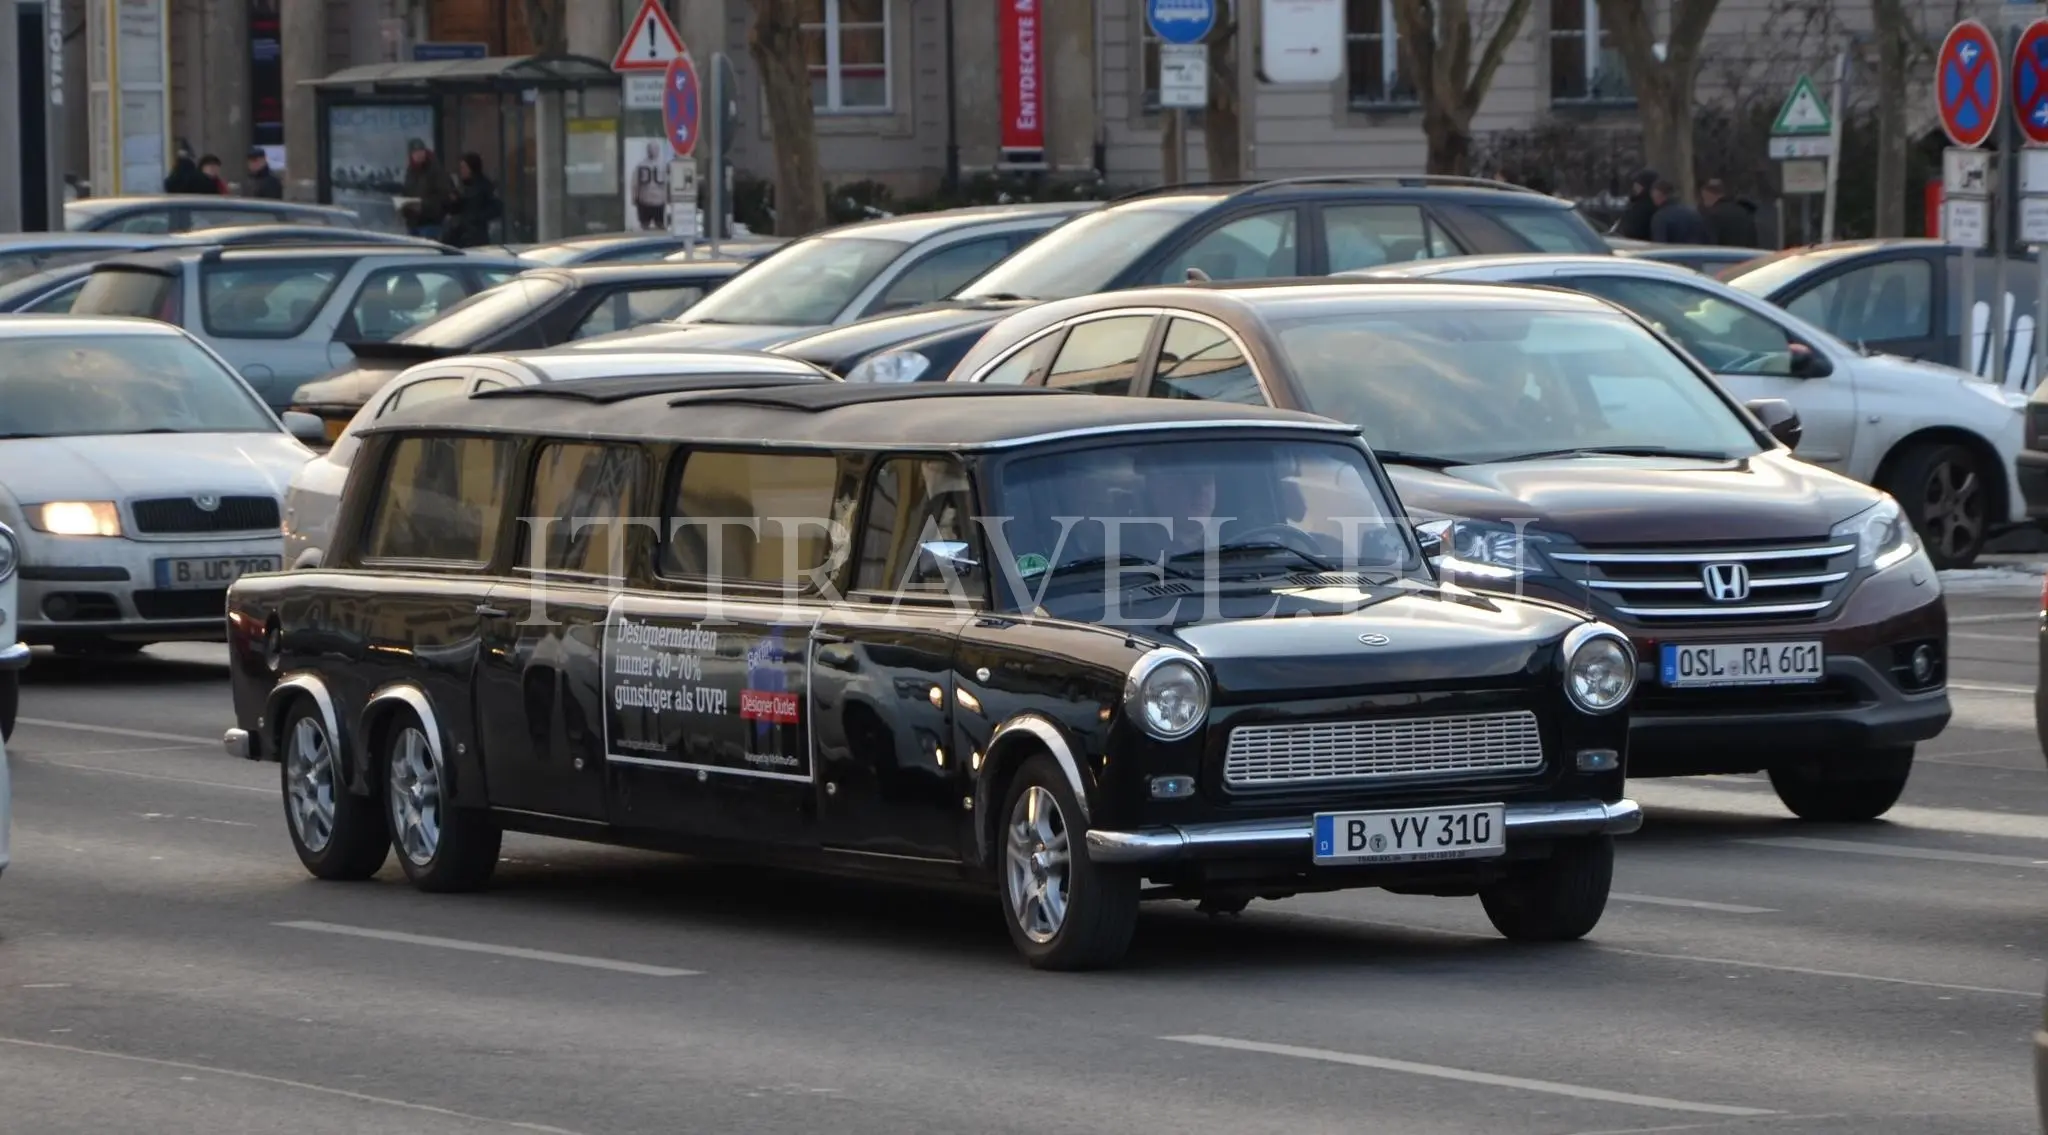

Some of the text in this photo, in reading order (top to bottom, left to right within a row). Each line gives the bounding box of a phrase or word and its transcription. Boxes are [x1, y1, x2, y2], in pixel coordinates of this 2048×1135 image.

[1016, 17, 1037, 129] ENTDECKTE
[177, 561, 191, 581] B
[203, 560, 231, 581] UC
[617, 617, 718, 651] Designermarken
[615, 648, 655, 674] immer
[1680, 649, 1724, 676] OSL
[1743, 647, 1772, 675] RA
[1779, 645, 1819, 673] 601
[614, 679, 728, 716] günstiger als UVP!
[741, 694, 797, 717] Designer Outlet
[1320, 841, 1329, 851] D
[1347, 811, 1491, 851] B YY 310
